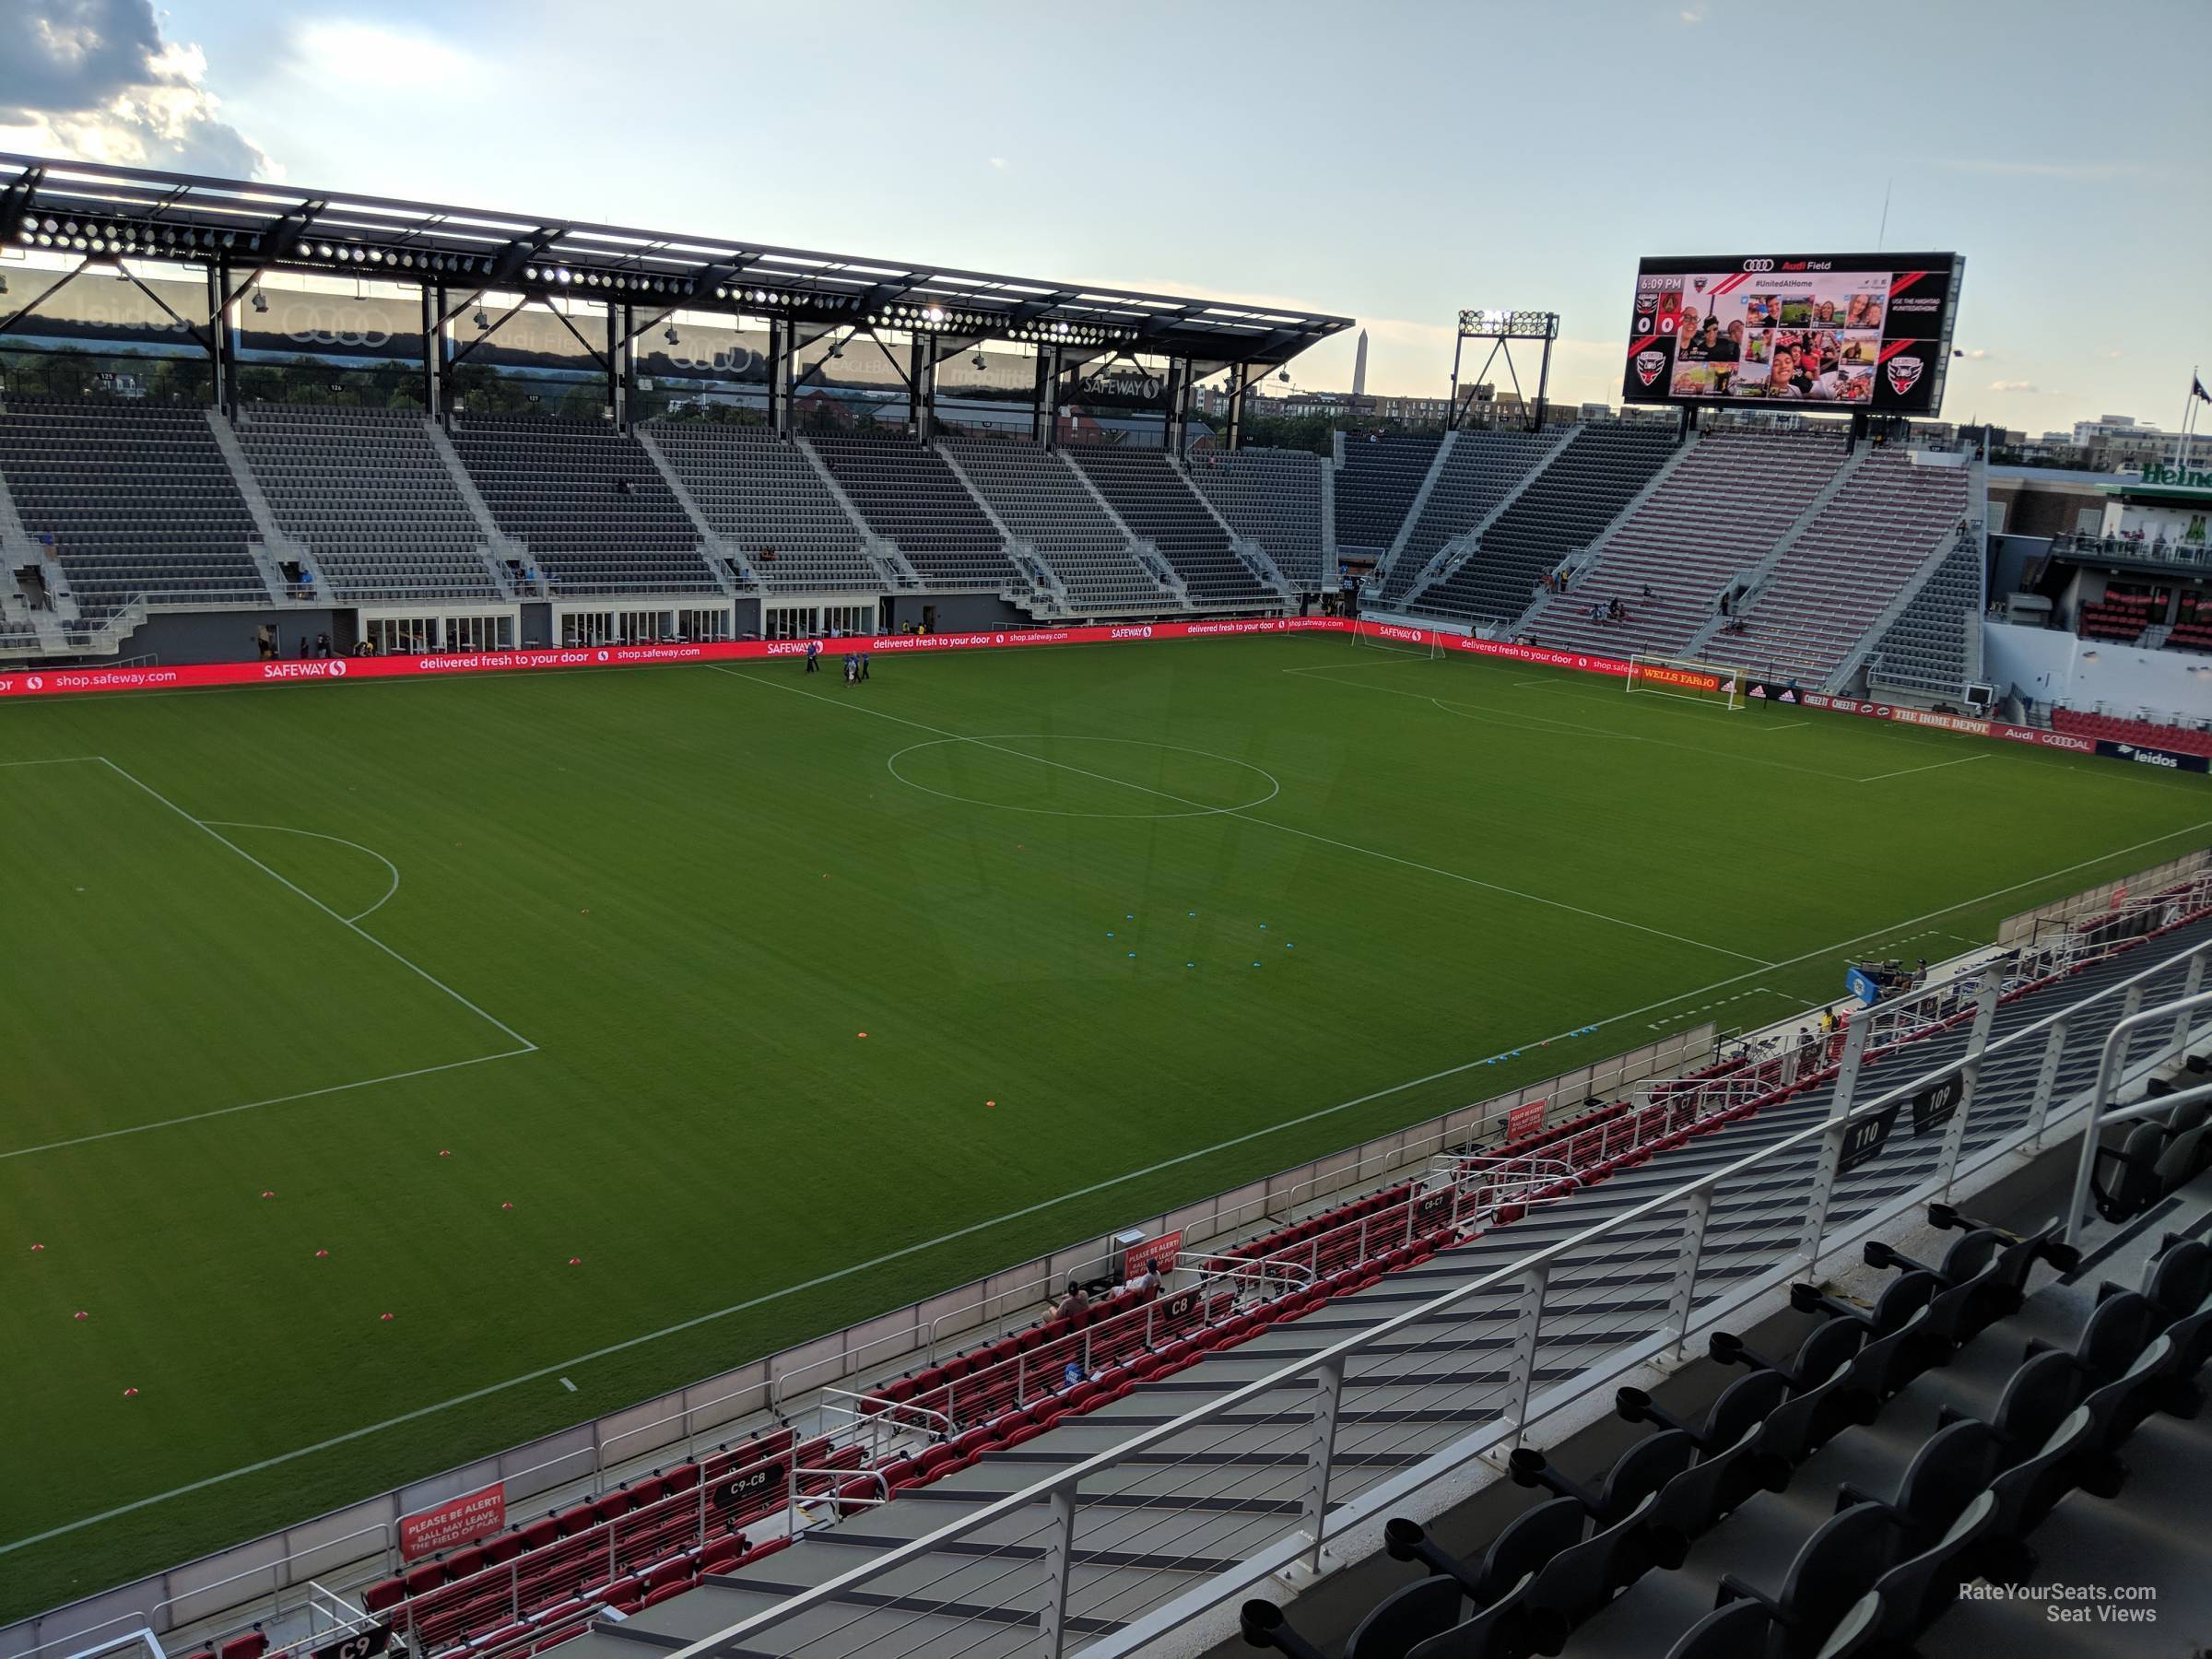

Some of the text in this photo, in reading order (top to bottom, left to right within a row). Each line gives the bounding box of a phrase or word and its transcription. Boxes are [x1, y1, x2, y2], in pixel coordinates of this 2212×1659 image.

[1783, 262, 1832, 271] Audi Field
[1641, 278, 1682, 289] 6:09 PM
[1755, 279, 1813, 288] #UnitedAtHome
[76, 293, 190, 333] leidos
[1638, 317, 1651, 333] 0
[1661, 317, 1674, 333] 0
[1009, 632, 1068, 642] shop.safeway.com
[1112, 629, 1142, 638] SAFEWAY
[1188, 624, 1218, 633] delivered
[1219, 623, 1234, 632] fresh
[1244, 623, 1258, 631] your
[1380, 627, 1411, 639] SAFEWAY
[874, 634, 990, 650] delivered fresh to your door
[420, 651, 589, 670] delivered fresh to your door
[618, 647, 700, 660] shop.safeway.com
[1462, 639, 1572, 664] delivered fresh to your door
[265, 662, 327, 678] SAFEWAY
[1644, 668, 1715, 688] WELLS FARGO
[56, 671, 176, 688] shop.safeway.com
[1895, 709, 1917, 722] THE
[1919, 712, 1950, 727] HOME
[1952, 718, 1989, 733] DEPOT
[2005, 728, 2033, 740] Audi
[2134, 749, 2178, 768] leidos
[1930, 1085, 1951, 1112] 109
[1855, 1121, 1878, 1149] 110
[1129, 1249, 1149, 1264] PLEASE
[1150, 1246, 1159, 1254] BE
[1159, 1239, 1180, 1251] ALERT!
[1171, 1297, 1188, 1315] C8
[730, 1472, 766, 1495] C9-C8
[408, 1494, 501, 1535] PLEASE BE ALERT!
[418, 1510, 496, 1544] BALL MAY LEAVE
[410, 1540, 429, 1551] THE
[432, 1531, 460, 1546] FIELD
[462, 1526, 475, 1535] OF
[339, 1636, 371, 1659] C9
